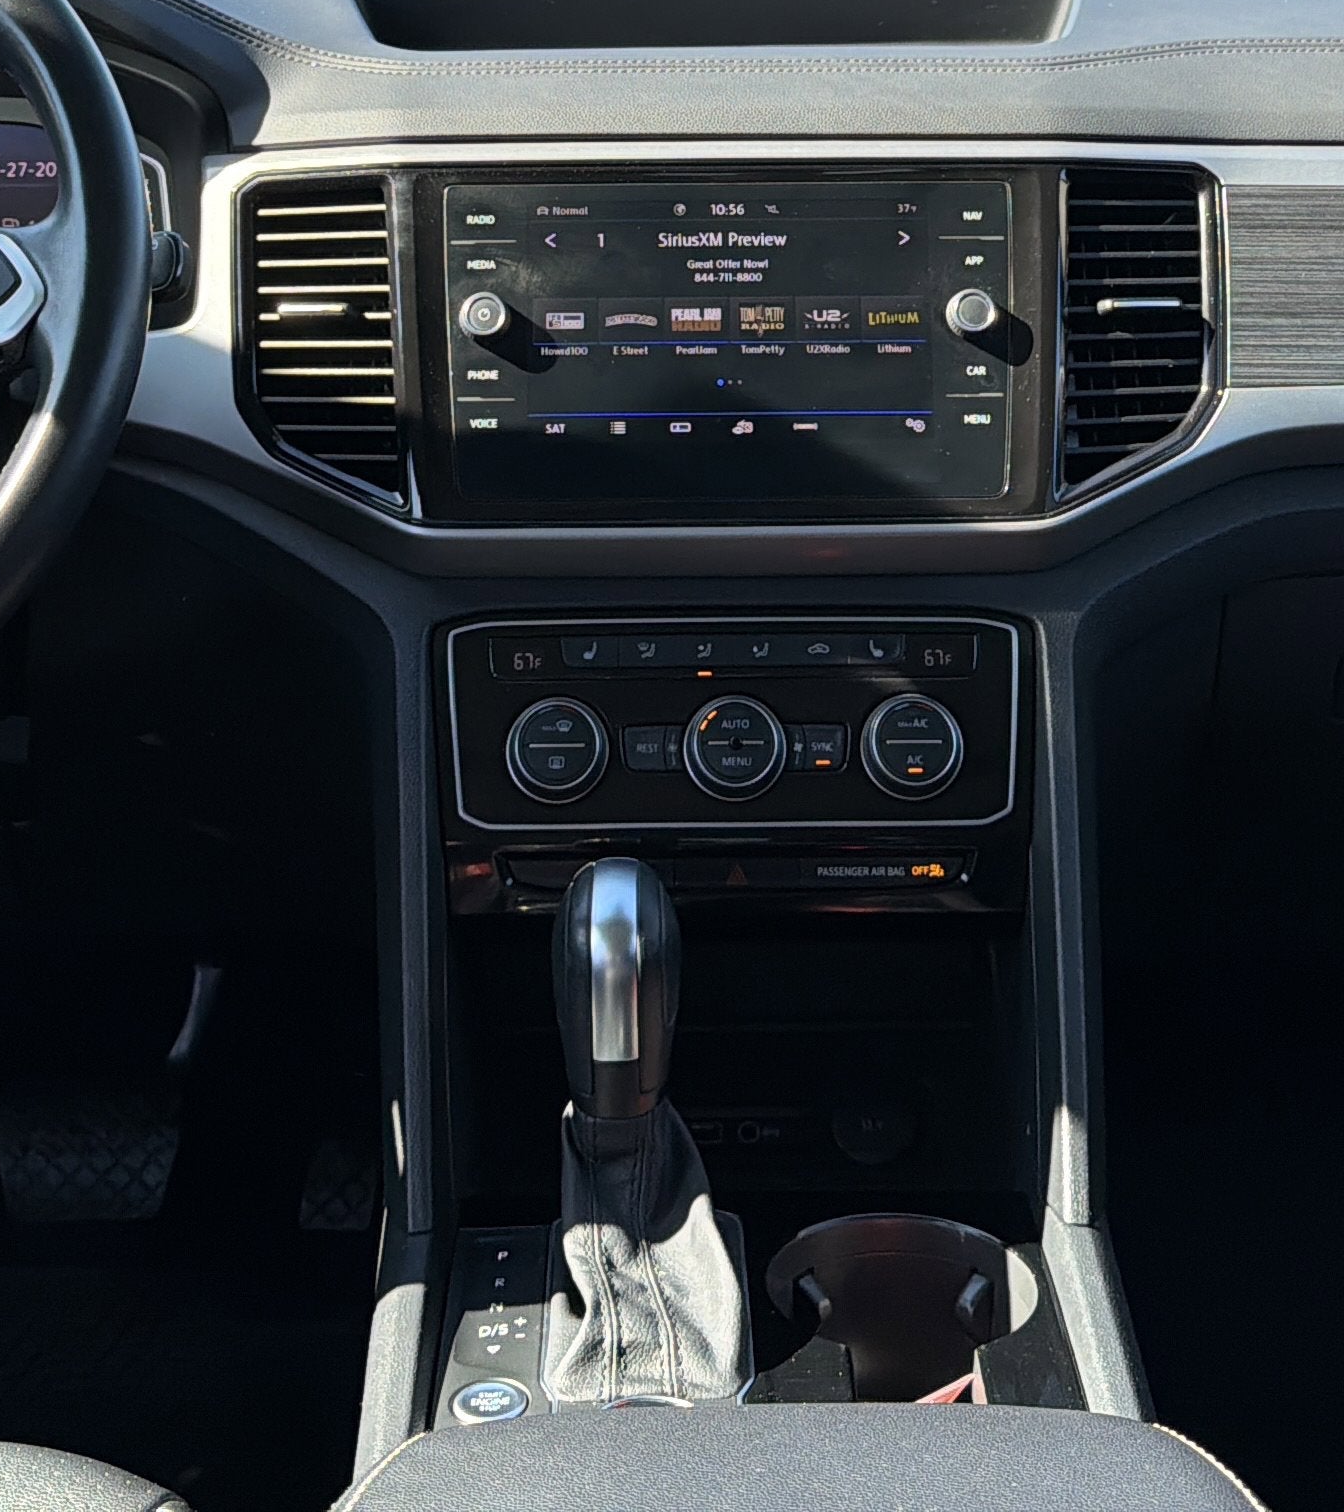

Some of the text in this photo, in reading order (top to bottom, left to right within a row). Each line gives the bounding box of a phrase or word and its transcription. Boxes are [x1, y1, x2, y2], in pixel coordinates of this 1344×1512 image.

[552, 206, 589, 216] Normal
[709, 203, 745, 216] 10:56
[466, 215, 495, 225] RADIO
[962, 211, 983, 221] NAV
[597, 232, 787, 248] 1 SiriusXM Preview
[466, 260, 497, 270] MEDIA
[686, 258, 769, 270] Great Offer Now!
[964, 256, 985, 266] APP
[694, 272, 763, 283] 844-711-8800
[671, 308, 700, 321] PEARL
[740, 306, 785, 322] TOM PETTY
[812, 309, 841, 322] U2
[620, 346, 648, 355] Street
[675, 345, 718, 355] PearlJam
[741, 344, 785, 356] TomPetty
[806, 344, 850, 354] U2XRadio
[877, 344, 911, 354] Lithium
[467, 370, 499, 381] PHONE
[966, 366, 987, 376] CAR
[469, 418, 498, 429] VOICE
[963, 414, 991, 425] MENU
[545, 424, 566, 434] SAT
[721, 719, 750, 730] AUTO
[912, 718, 929, 729] A/C
[636, 743, 659, 754] REST
[810, 742, 834, 753] SYNC
[721, 756, 752, 767] MENU
[906, 754, 924, 765] A/C
[817, 865, 929, 877] PASSENGER AIR BAG OFF
[497, 1250, 508, 1261] P
[494, 1277, 505, 1288] R
[478, 1322, 509, 1339] D/S
[470, 1396, 511, 1407] ENGINE
